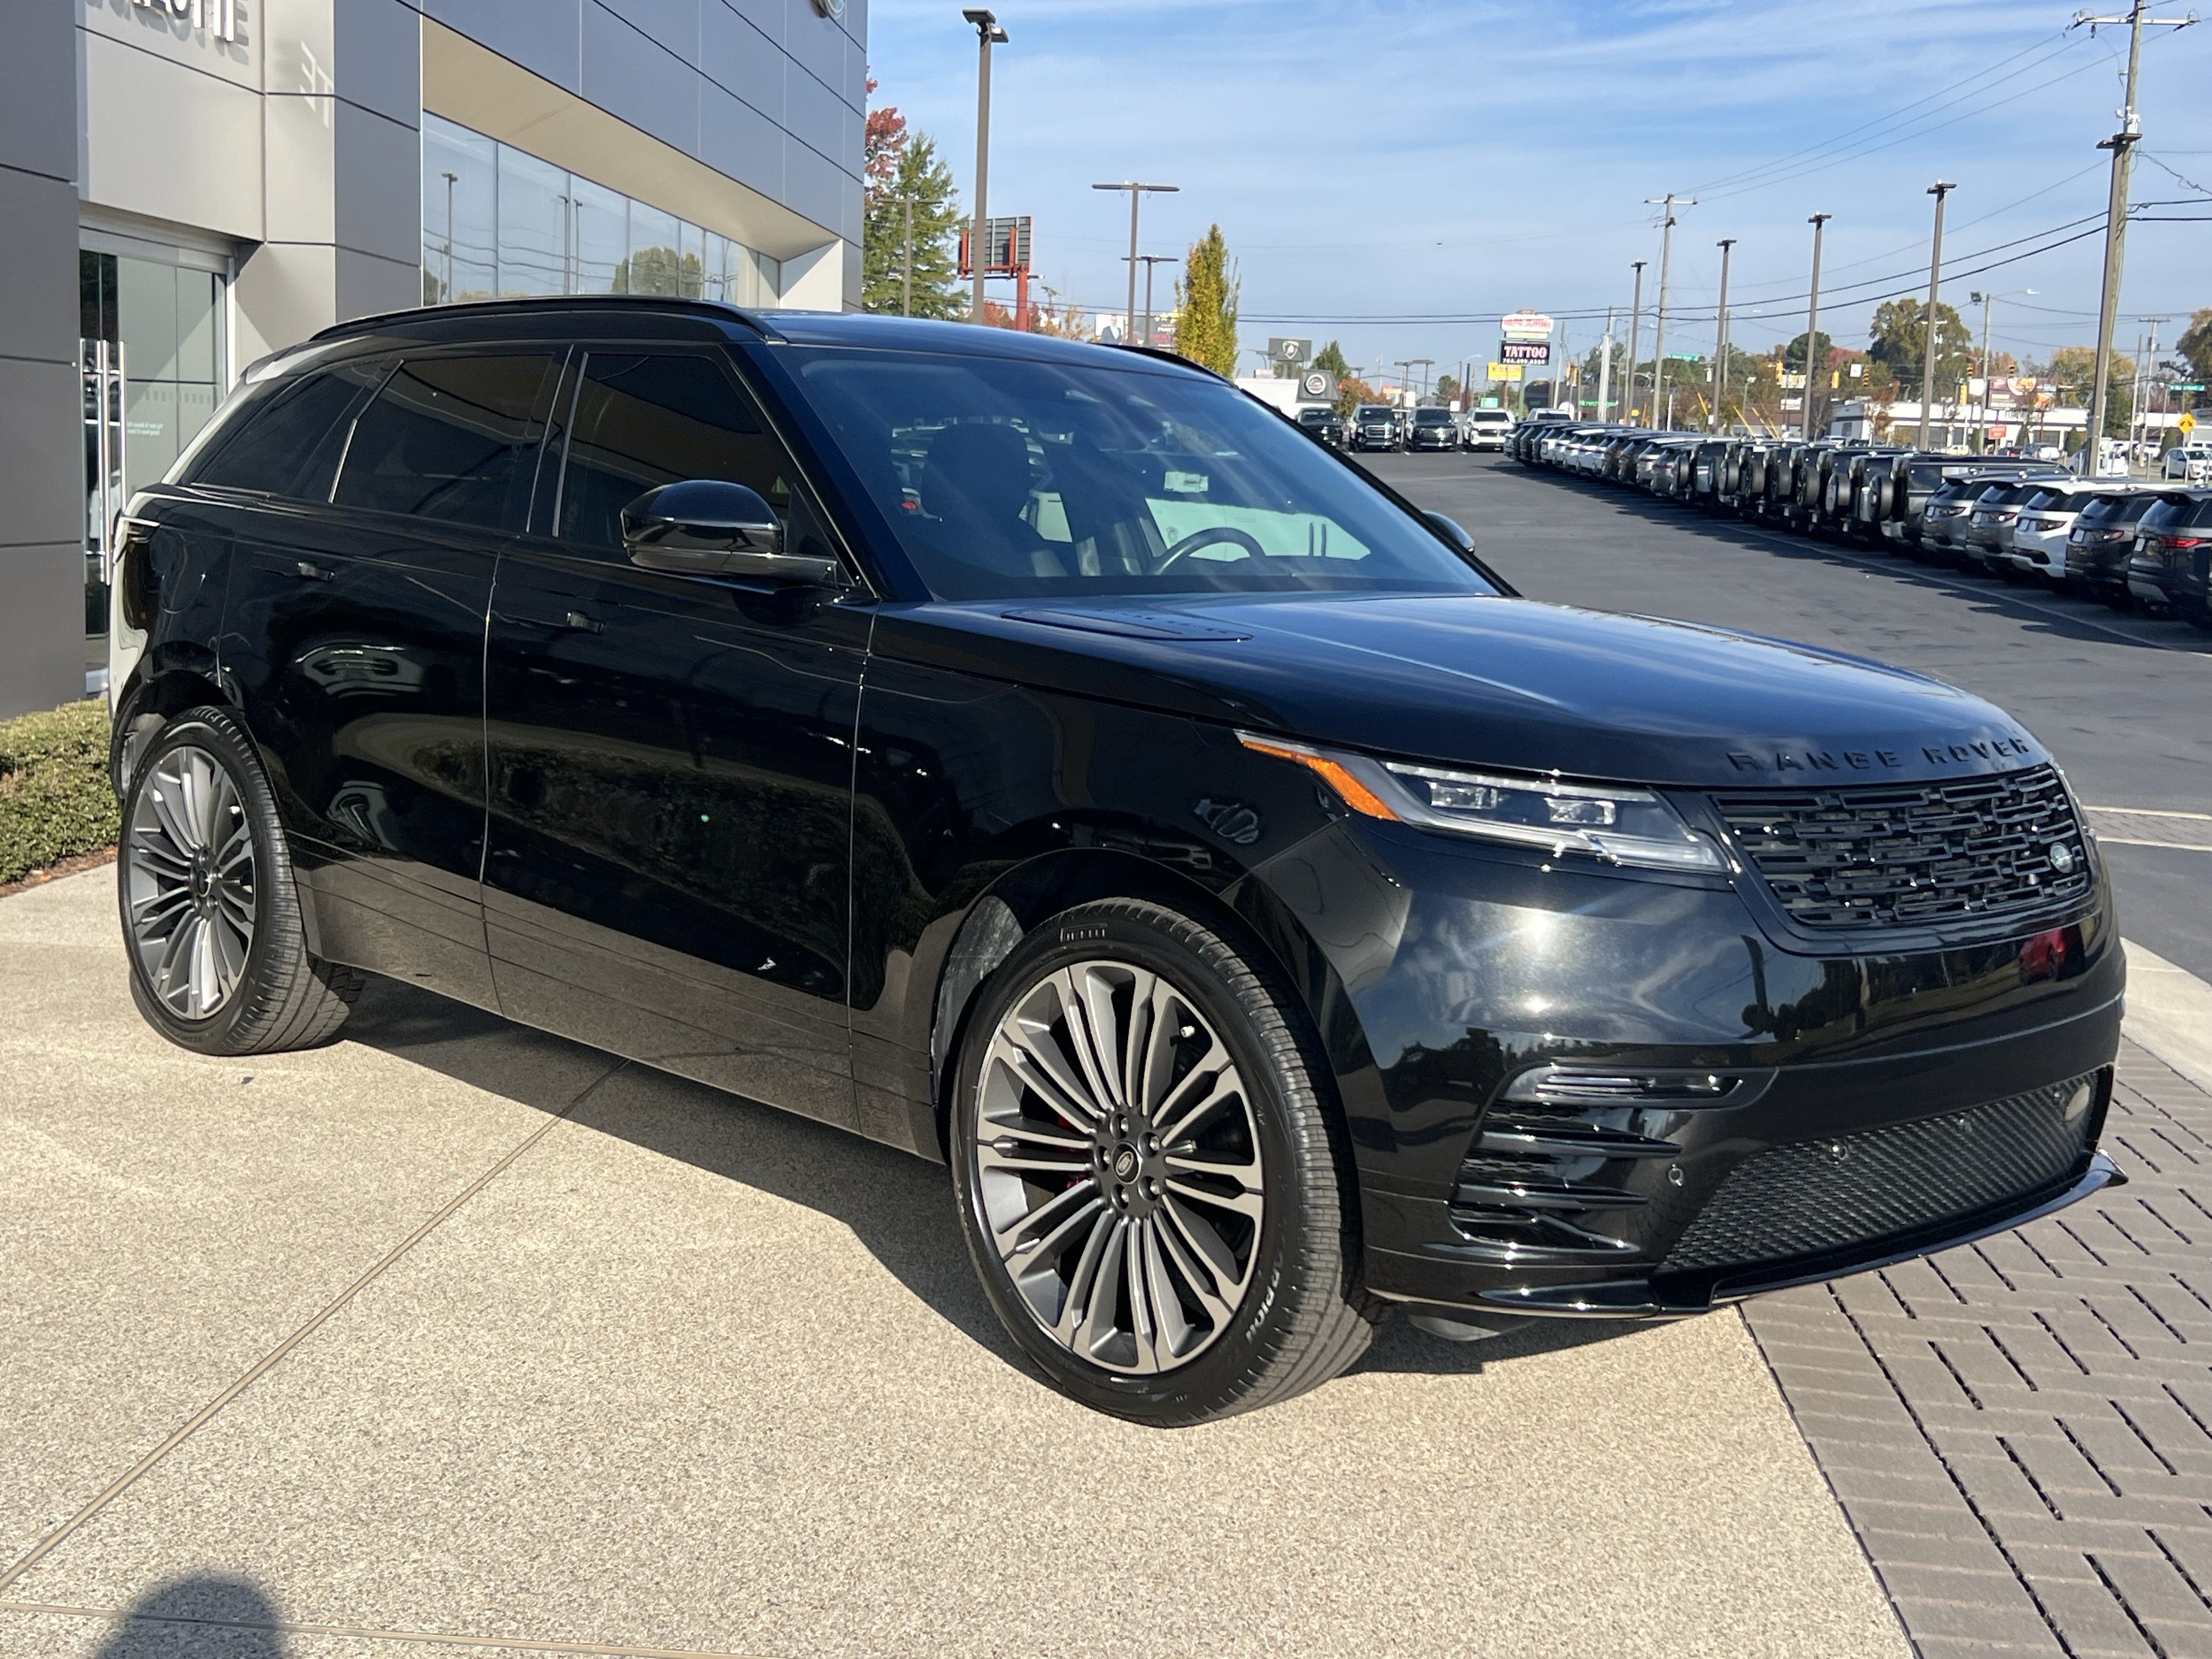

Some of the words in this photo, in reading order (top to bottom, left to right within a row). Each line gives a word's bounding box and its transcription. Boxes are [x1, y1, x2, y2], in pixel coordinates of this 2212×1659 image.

[1504, 346, 1547, 358] TATTOO
[1726, 749, 1904, 771] RANGE
[1921, 737, 2030, 764] ROVER
